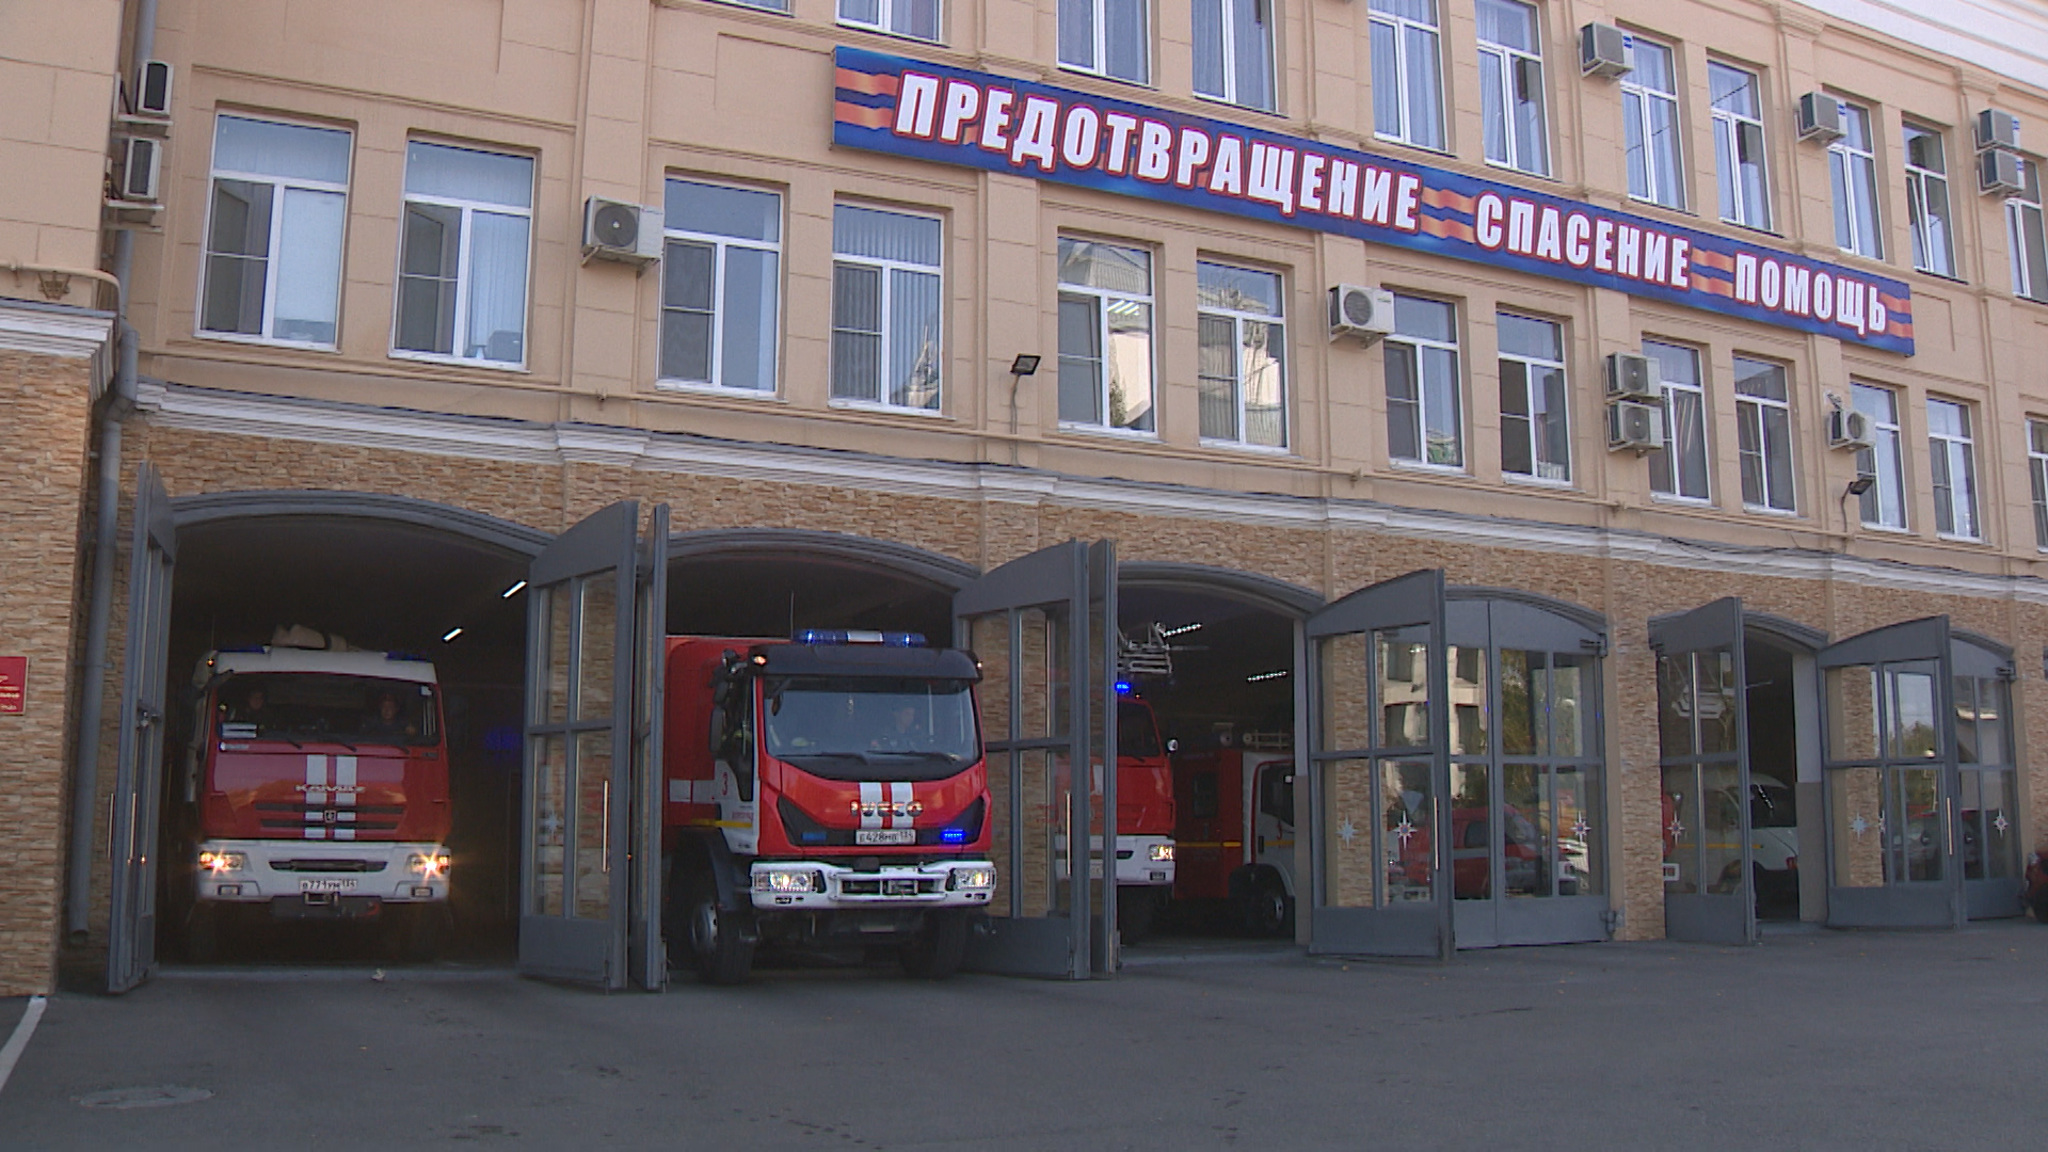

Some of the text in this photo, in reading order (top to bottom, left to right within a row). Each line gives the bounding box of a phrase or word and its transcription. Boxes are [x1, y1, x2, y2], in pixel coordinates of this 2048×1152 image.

[896, 73, 1887, 336] ПРЕДОТВРАЩЕНИЕ СПАСЕНИЕ ПОМОЩЬ
[850, 801, 924, 817] IVECO
